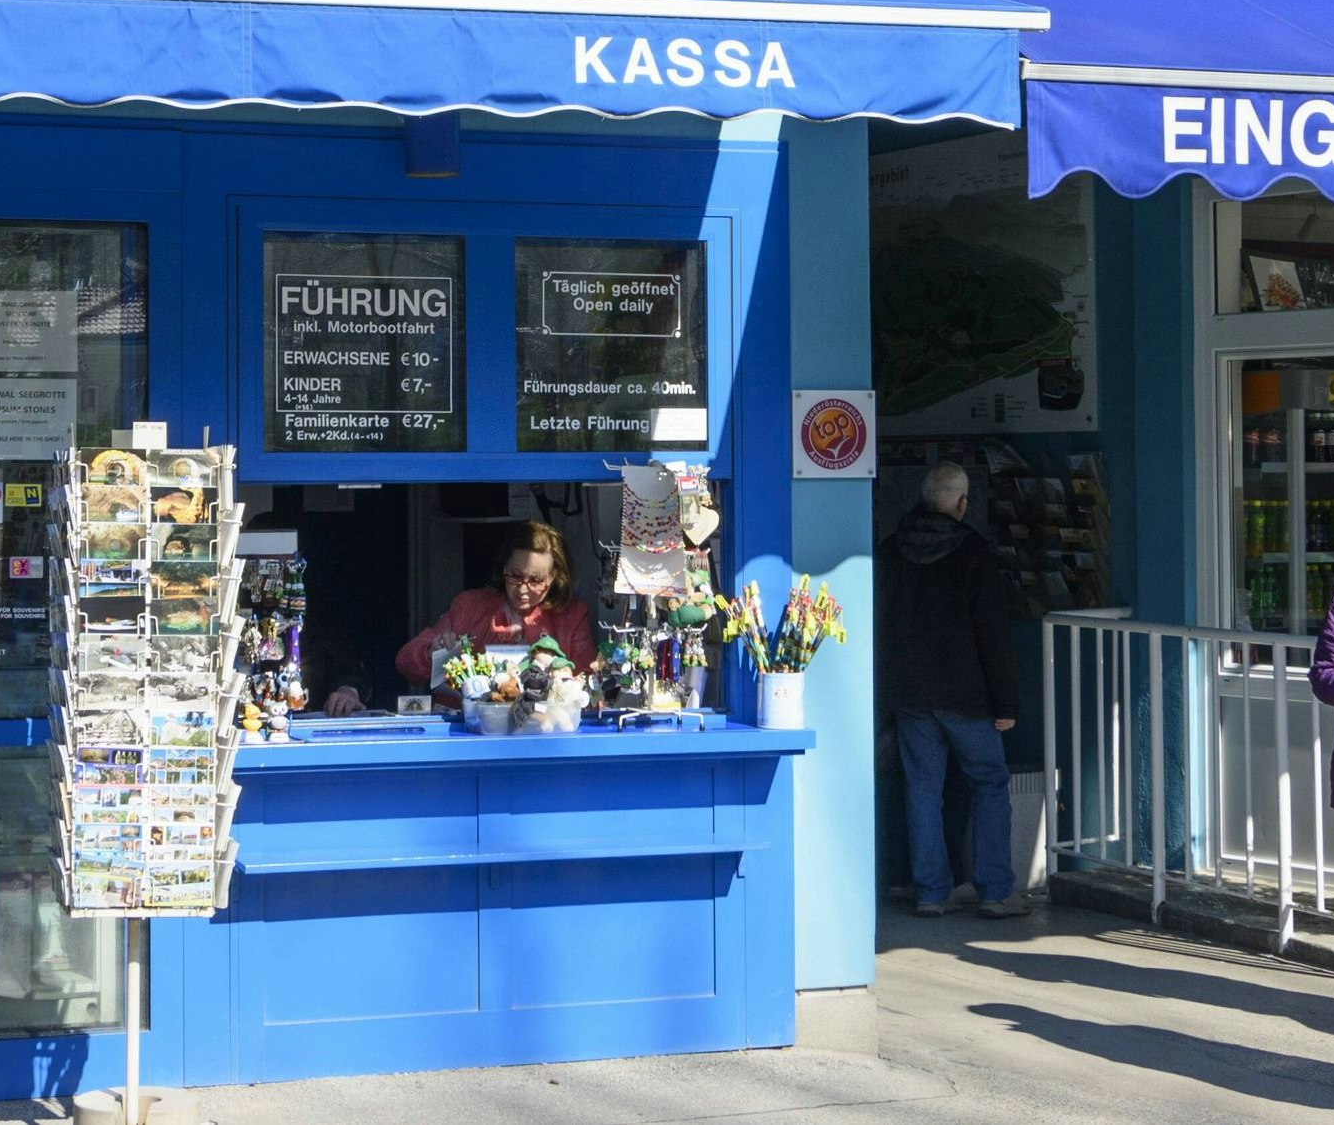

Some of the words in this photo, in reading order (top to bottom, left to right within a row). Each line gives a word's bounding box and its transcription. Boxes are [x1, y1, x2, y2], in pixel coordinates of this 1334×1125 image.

[574, 35, 796, 88] KASSA
[552, 279, 605, 295] Täglich
[611, 282, 675, 297] geöffnet
[281, 279, 447, 317] FÜHRUNG
[573, 297, 613, 313] Open
[619, 299, 654, 315] daily
[293, 320, 322, 333] inkl.
[327, 321, 435, 335] Motorbootfahrt
[283, 351, 390, 366] ERWACHSENE
[283, 377, 342, 392] KINDER
[523, 379, 622, 396] Führungsdauer
[627, 383, 647, 394] ca.
[18, 391, 67, 399] SEEGROTTE
[312, 394, 341, 404] Jahre
[23, 405, 56, 414] STONES
[285, 413, 389, 428] Familienkarte
[530, 415, 581, 431] Letzte
[587, 415, 651, 434] Führung
[814, 414, 850, 439] top
[285, 430, 293, 441] 2
[808, 449, 860, 470] Ausflugsziele
